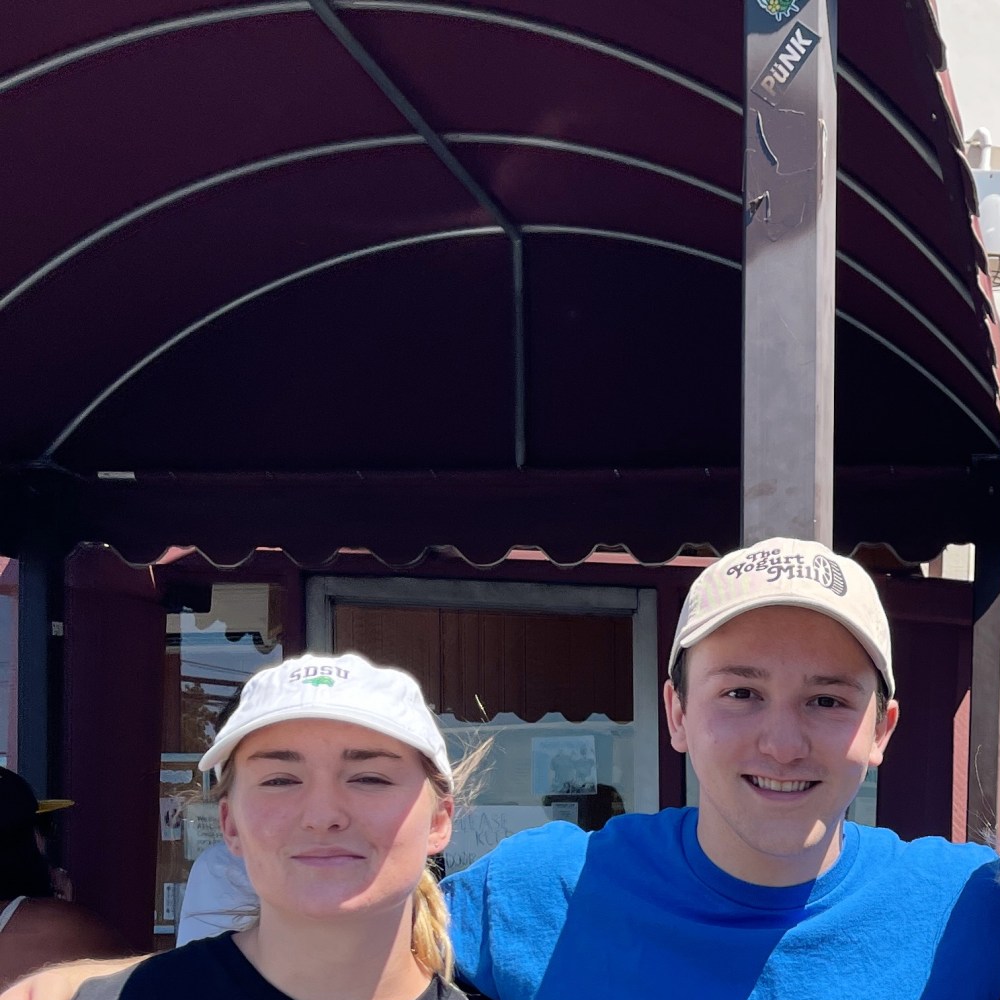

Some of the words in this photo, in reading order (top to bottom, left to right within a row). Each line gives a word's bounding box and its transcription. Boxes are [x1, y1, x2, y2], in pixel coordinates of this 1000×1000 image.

[745, 547, 782, 563] The
[727, 554, 805, 579] Yogurt
[766, 565, 821, 583] Mill
[289, 665, 352, 683] SDSU
